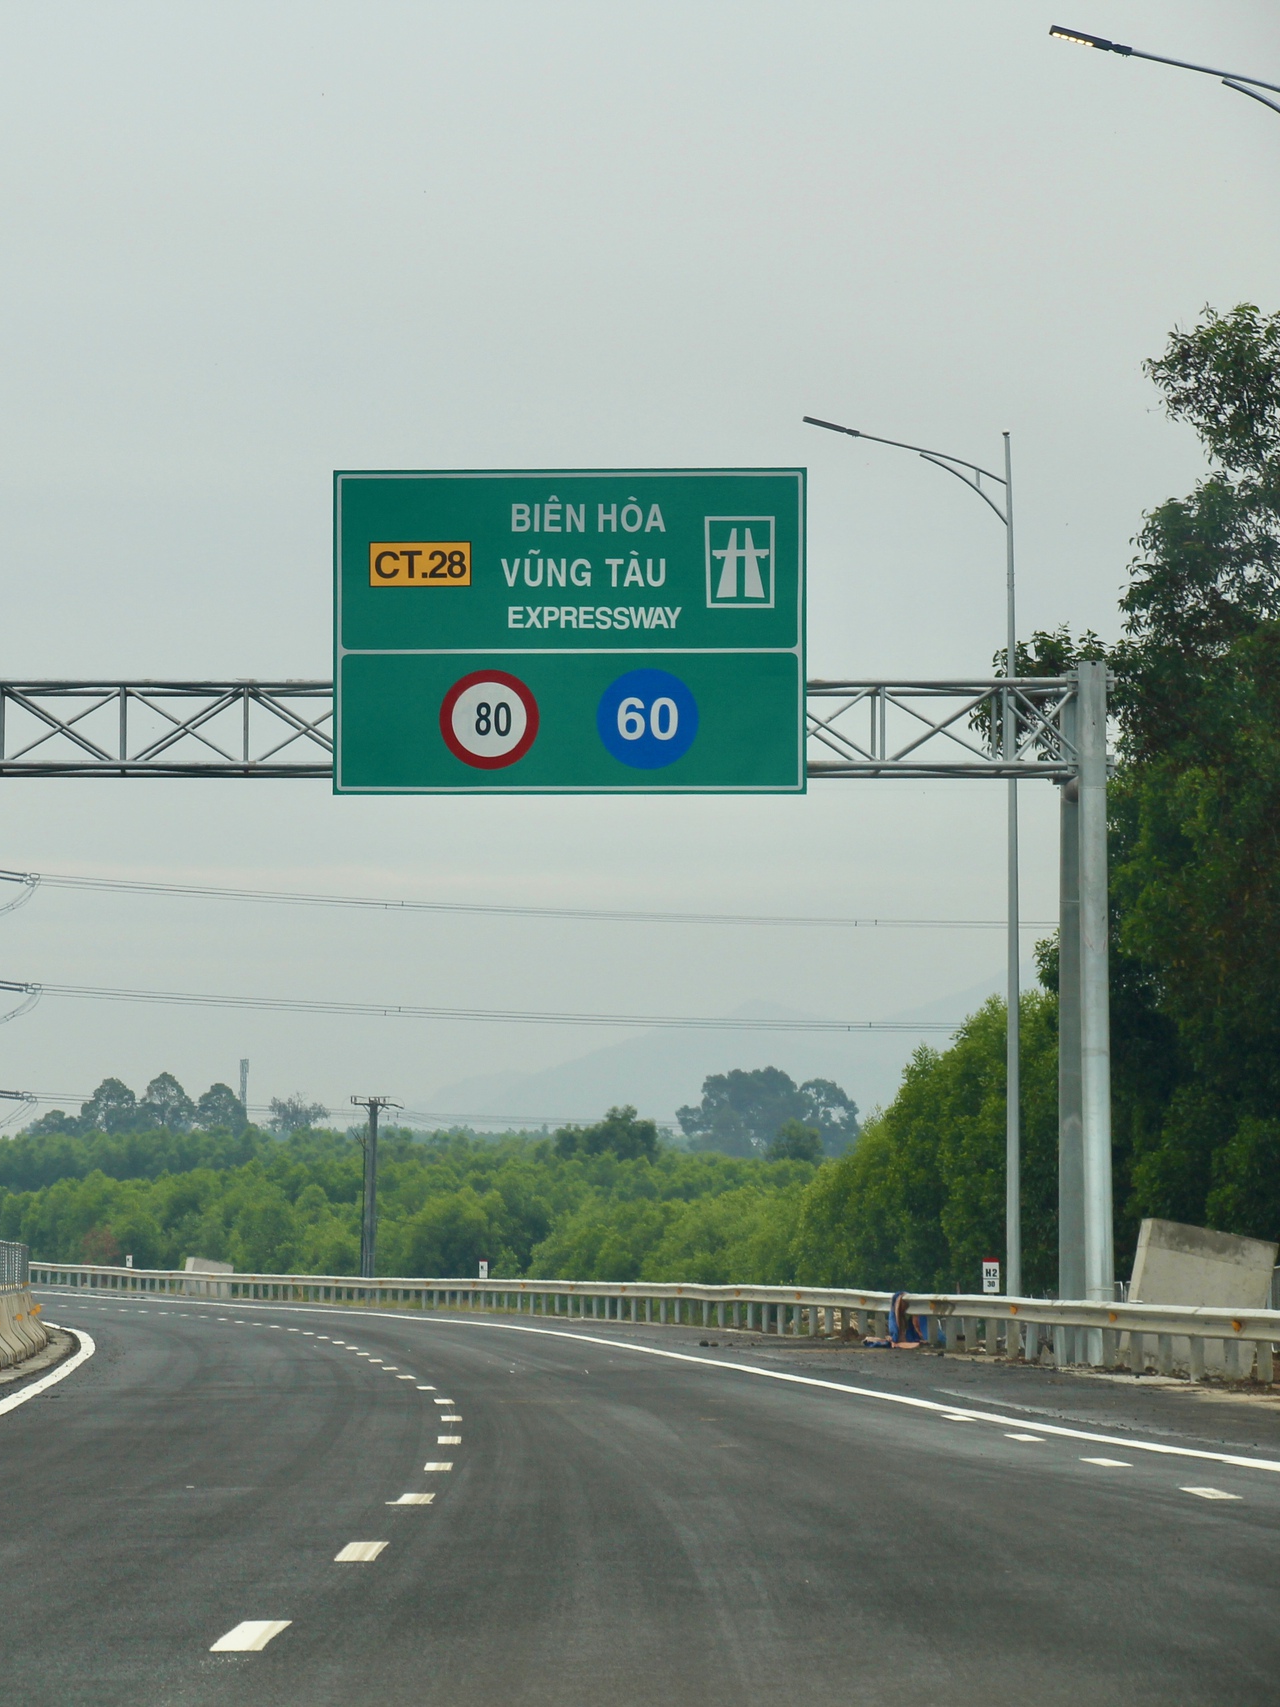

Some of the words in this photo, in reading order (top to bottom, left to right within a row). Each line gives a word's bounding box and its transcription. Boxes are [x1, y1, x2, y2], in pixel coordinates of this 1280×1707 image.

[511, 495, 585, 532] BIÊN
[598, 496, 666, 532] HÒA
[375, 550, 466, 579] CT.28
[501, 549, 592, 587] VŨNG
[605, 550, 666, 587] TÀU
[508, 606, 682, 630] EXPRESSWAY
[475, 702, 512, 737] 80
[617, 697, 679, 741] 60
[985, 1268, 998, 1278] H2
